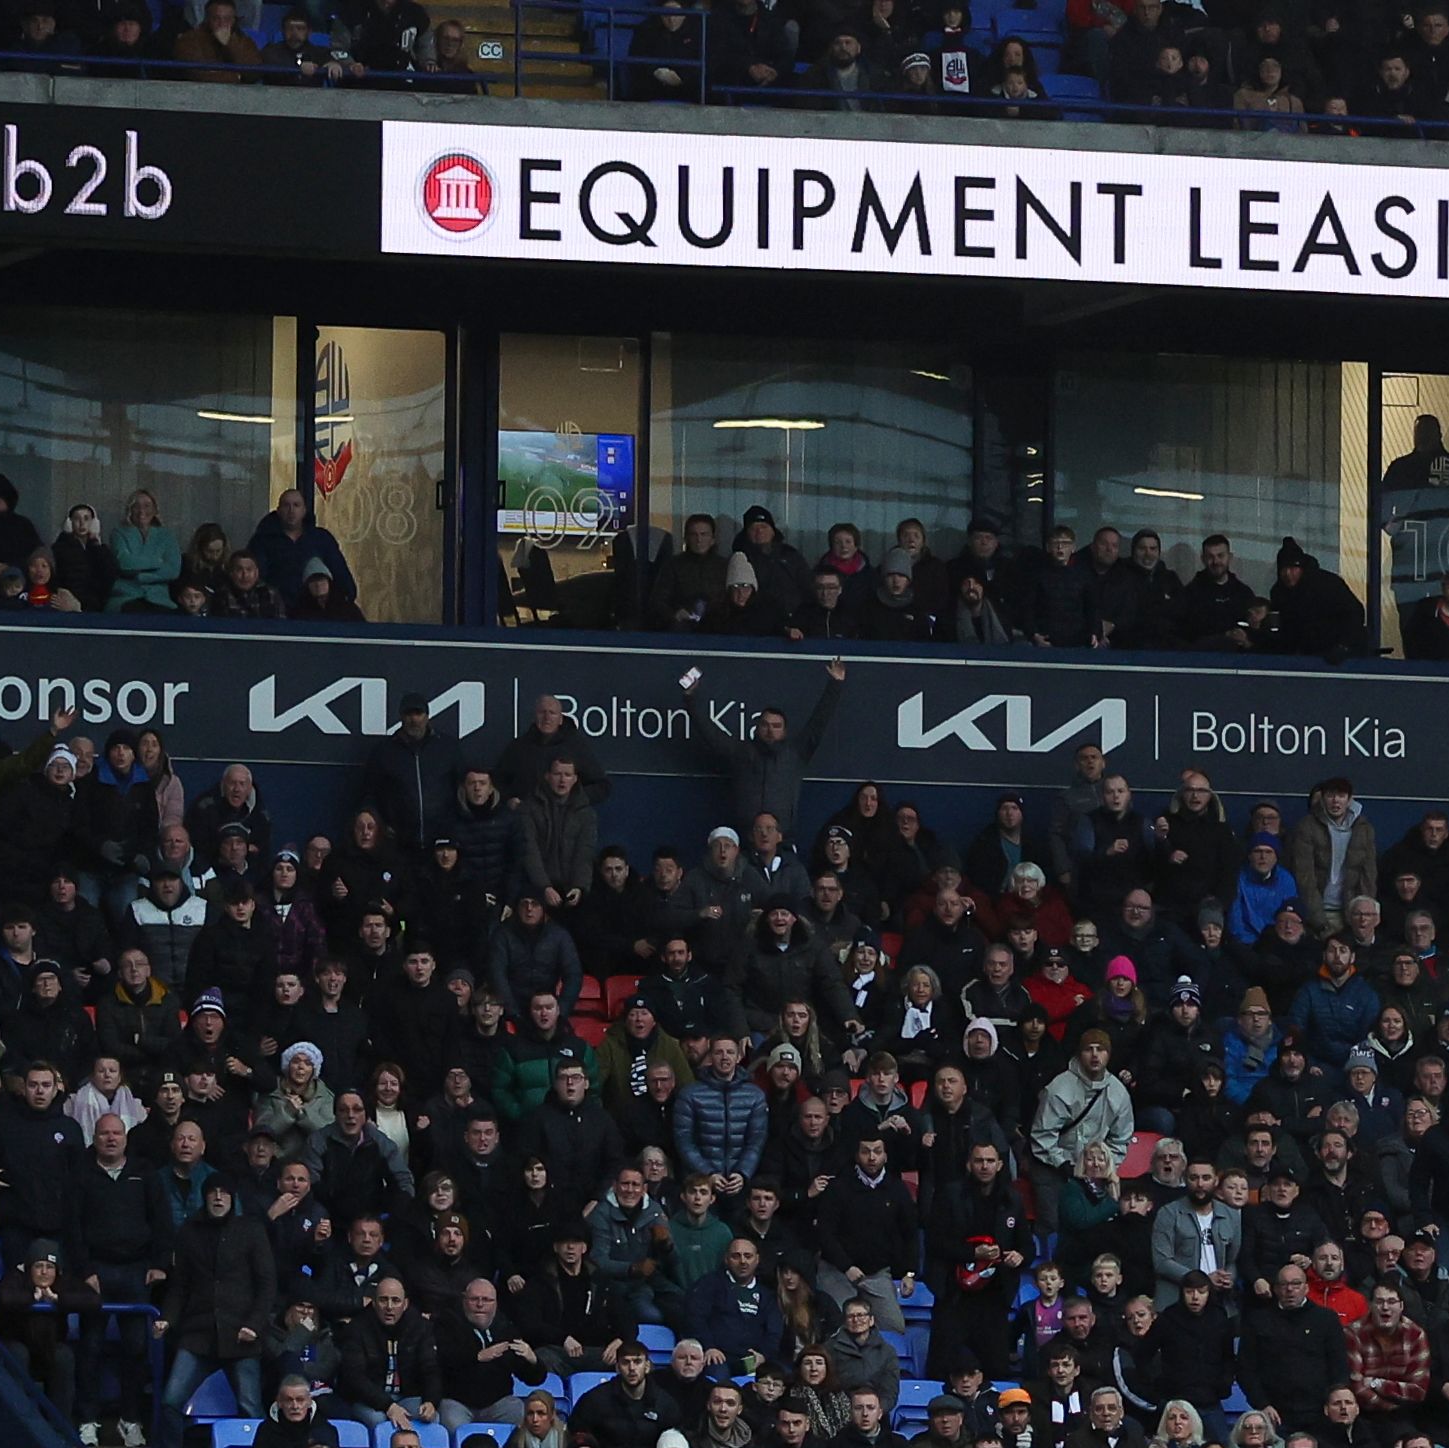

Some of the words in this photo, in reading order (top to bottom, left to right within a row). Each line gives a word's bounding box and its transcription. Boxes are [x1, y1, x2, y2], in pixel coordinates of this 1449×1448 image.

[3, 123, 173, 221] b2b
[518, 158, 1143, 266] EQUIPMENT
[523, 486, 615, 549] 09
[249, 674, 484, 737] KIA
[897, 691, 1127, 752] KIA
[1192, 712, 1327, 756] Bolton
[1345, 717, 1406, 759] Kia
